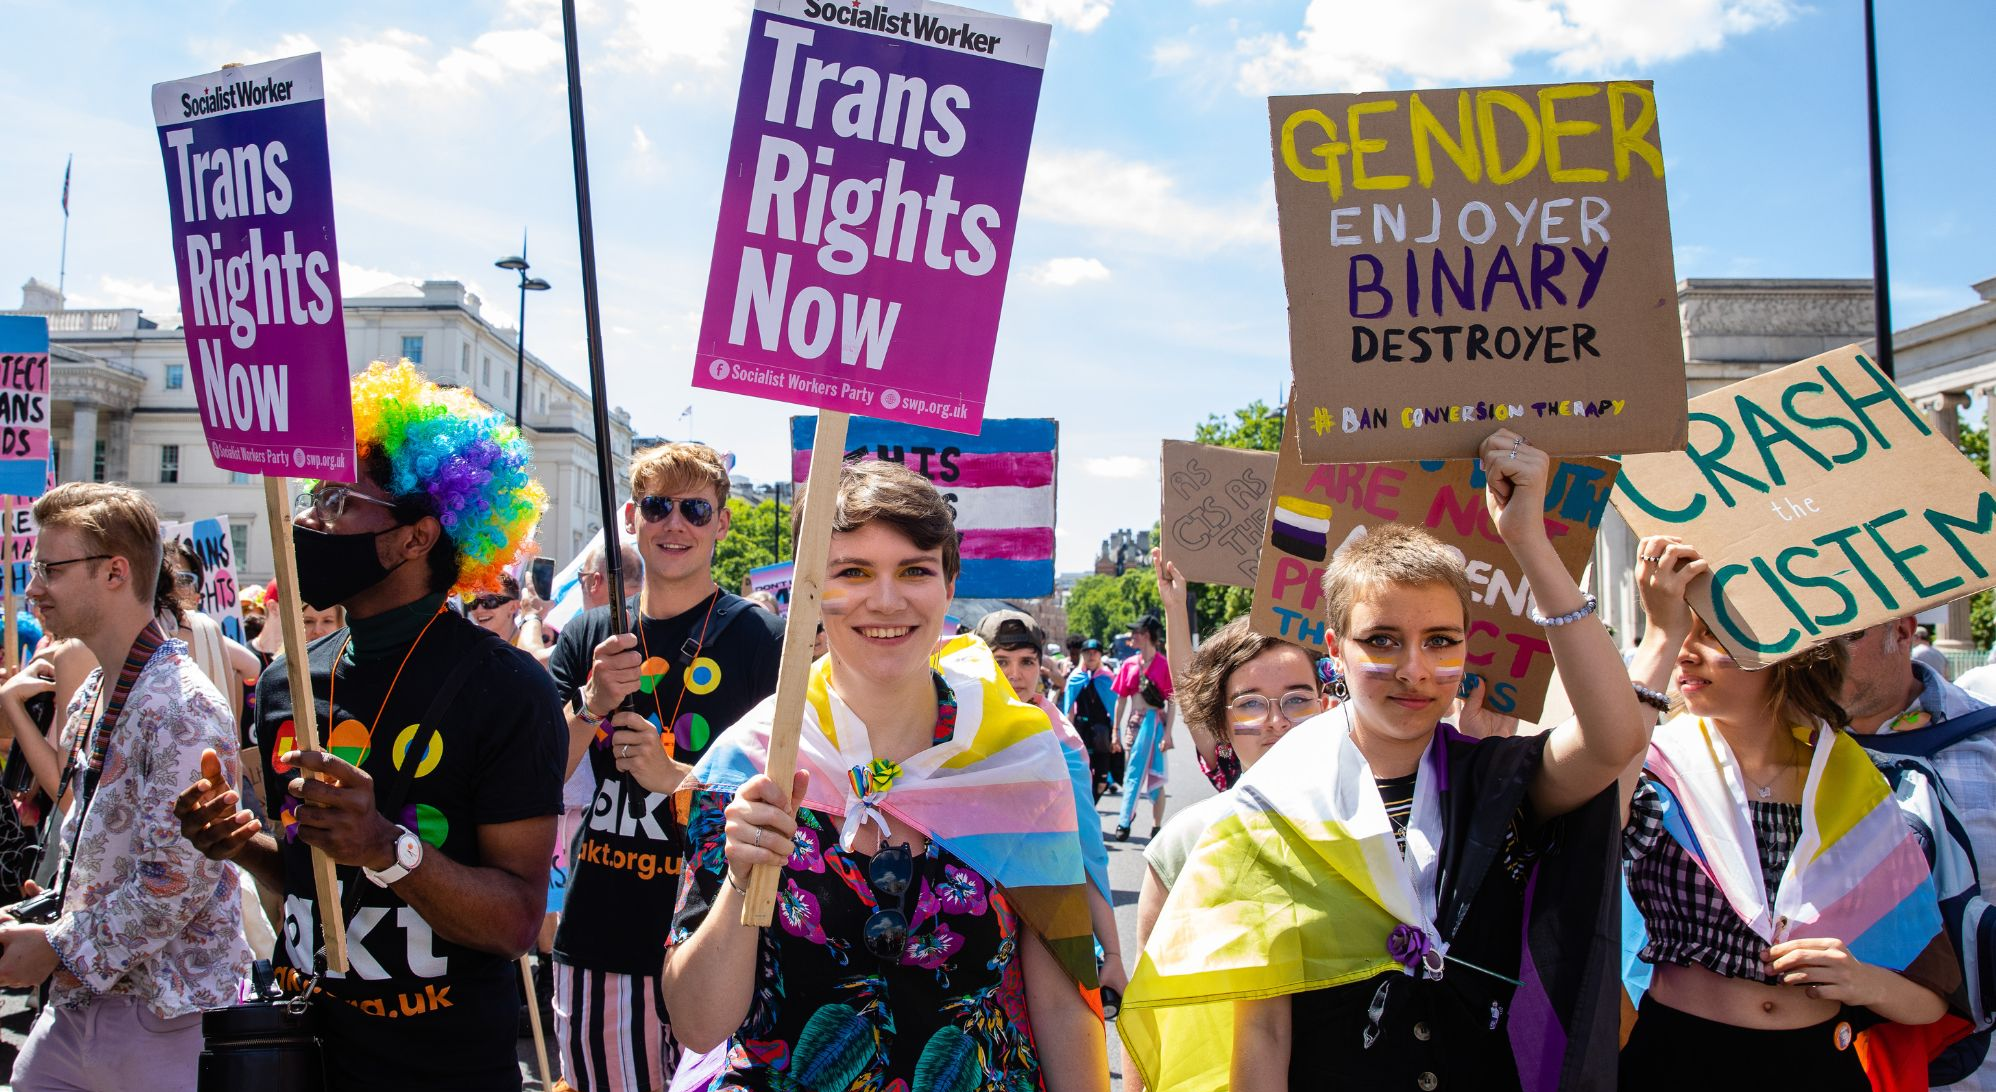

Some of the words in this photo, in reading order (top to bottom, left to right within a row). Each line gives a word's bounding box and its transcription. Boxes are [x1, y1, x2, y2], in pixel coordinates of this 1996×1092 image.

[763, 19, 971, 157] Trans
[166, 127, 293, 222] Trans
[1281, 81, 1664, 203] GENDER
[746, 134, 1001, 277] Rights
[1331, 196, 1611, 247] ENJOYER
[186, 227, 333, 349] Rights
[728, 245, 902, 371] Now
[1348, 243, 1609, 319] BINARY
[1351, 323, 1601, 364] DESTROYER
[198, 338, 288, 432] Now
[731, 364, 785, 388] Socialist
[788, 373, 838, 397] Workers
[841, 382, 875, 405] Party
[902, 396, 969, 419] swp.org.uk
[1401, 401, 1525, 429] CONVERSION
[1531, 399, 1625, 418] THERAPY
[219, 443, 241, 460] Socialist
[240, 447, 266, 463] Workers
[267, 449, 289, 467] Party
[306, 453, 345, 470] swp.org.uk
[1171, 458, 1211, 500] AS
[1304, 463, 1407, 521] ARE
[1172, 496, 1231, 551] CIS
[1225, 468, 1266, 510] AS
[1771, 496, 1820, 523] the
